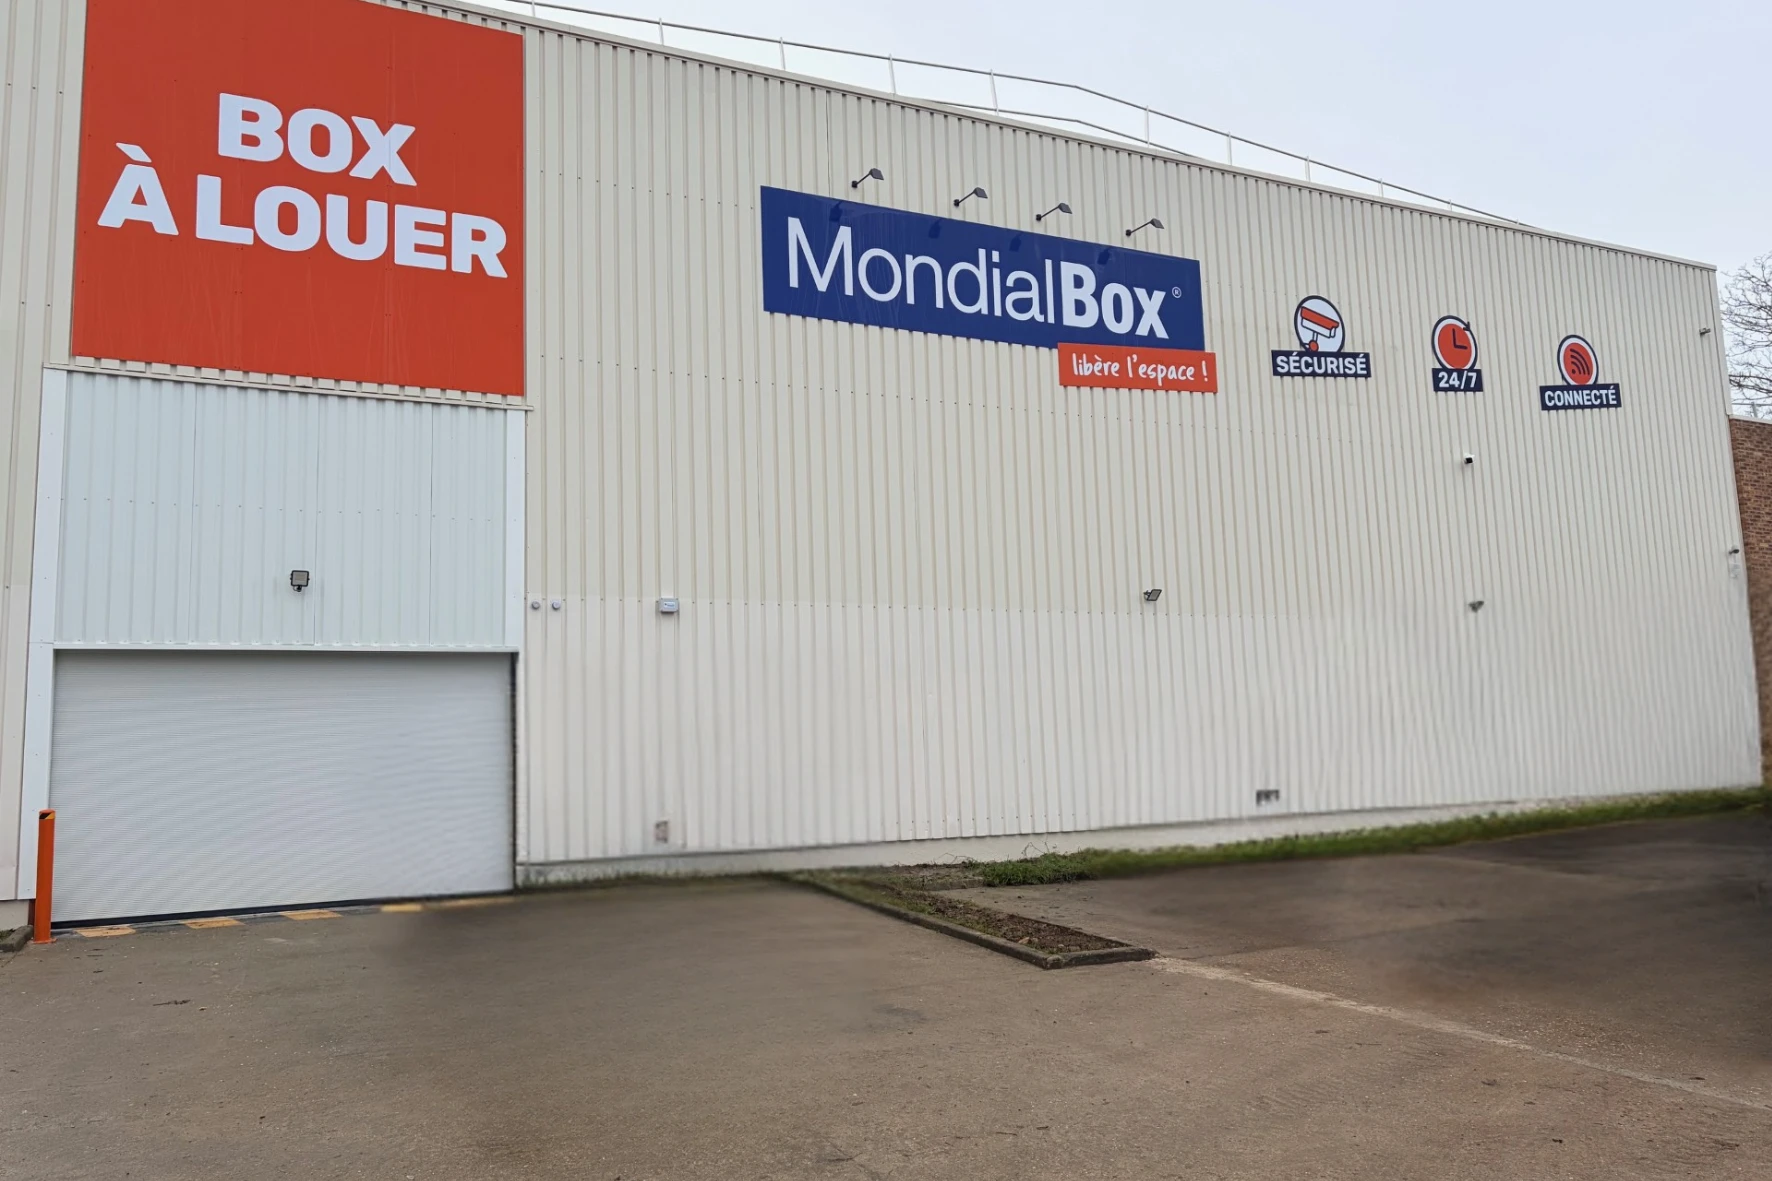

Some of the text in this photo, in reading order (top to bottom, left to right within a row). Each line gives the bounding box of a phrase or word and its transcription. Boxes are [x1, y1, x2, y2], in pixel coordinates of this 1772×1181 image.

[218, 93, 417, 186] BOX
[97, 142, 508, 278] À LOUER
[1072, 353, 1120, 377] libère
[1126, 354, 1195, 386] l'espace
[1276, 352, 1367, 375] SÉCURISÉ
[1438, 371, 1477, 389] 24/7
[1544, 386, 1617, 406] CONNECTÉ
